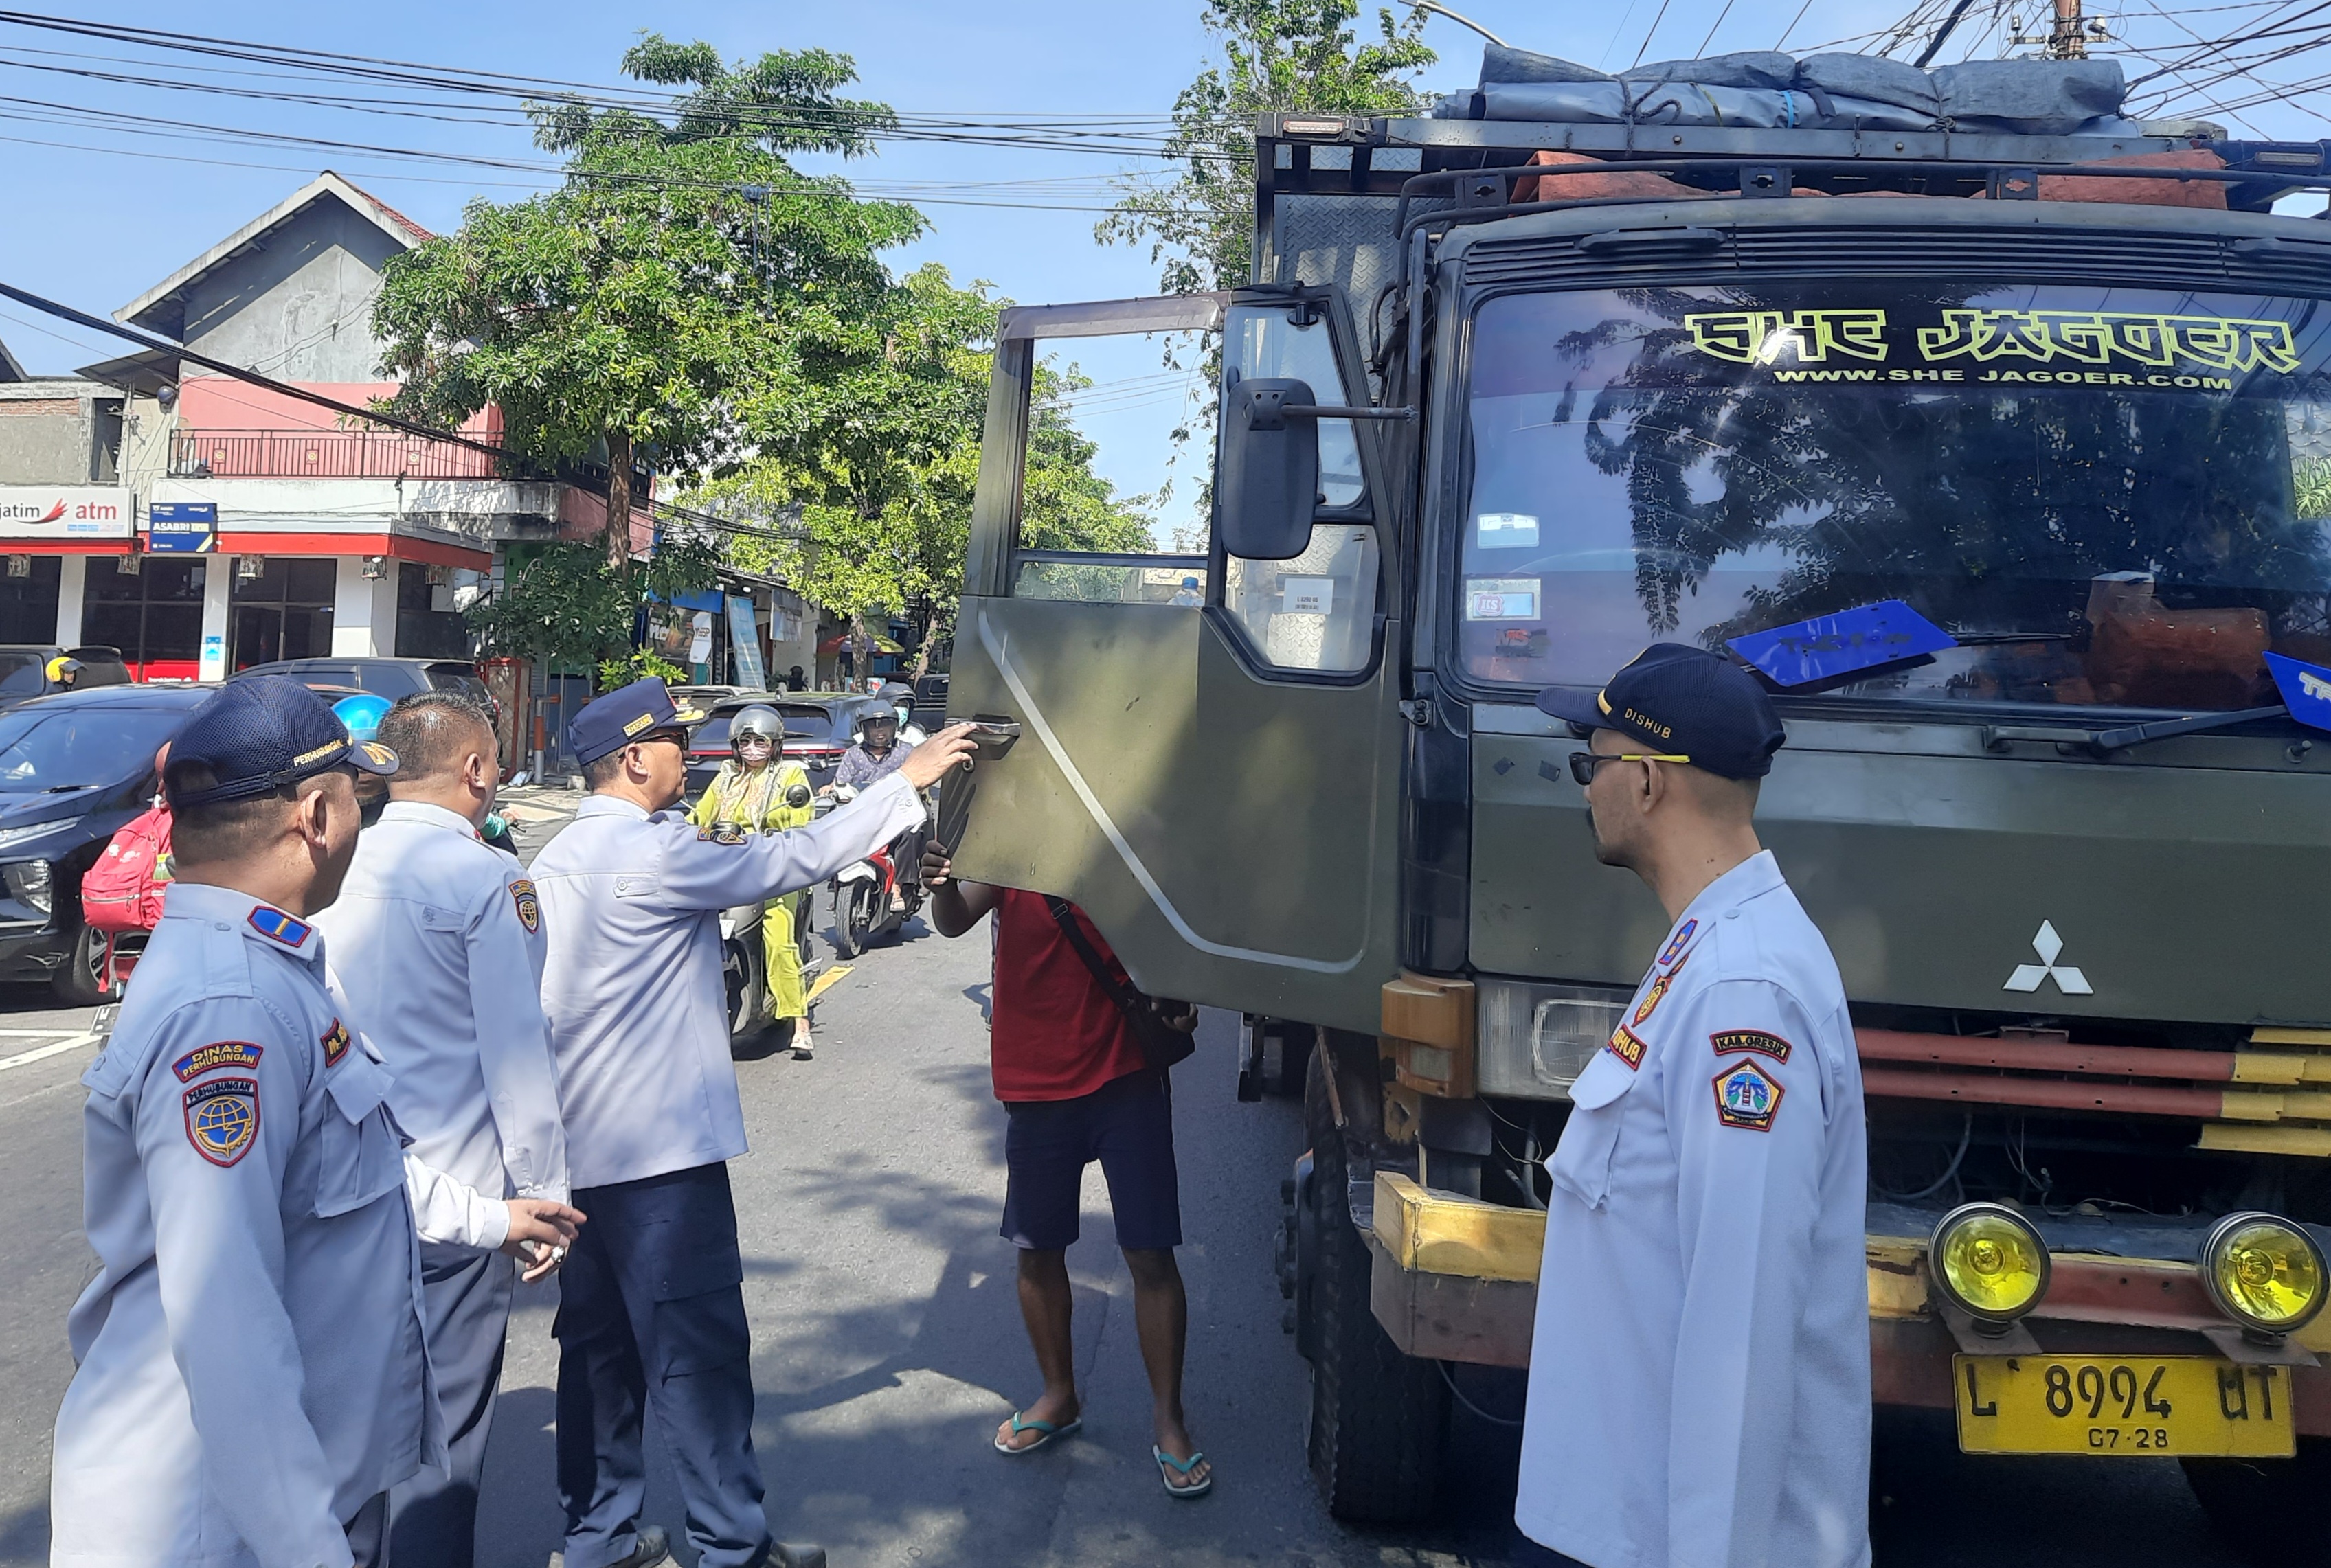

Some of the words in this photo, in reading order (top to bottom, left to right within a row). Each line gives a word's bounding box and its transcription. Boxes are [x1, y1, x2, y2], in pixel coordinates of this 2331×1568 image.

[1685, 309, 1889, 365] SHE
[1917, 310, 2301, 373] JAGOER
[1774, 370, 1964, 382] WWW.SHE
[1978, 371, 2232, 390] JAGOER.COM
[75, 501, 117, 520] atm
[153, 523, 190, 531] ASABRI
[1624, 707, 1672, 739] DISHUB
[192, 1044, 244, 1063] DINAS
[183, 1052, 255, 1077] PERHUBUNGAN
[188, 1080, 251, 1100] PERHUBUNGAN
[1966, 1363, 1997, 1416] L
[2045, 1364, 2172, 1419] 8994
